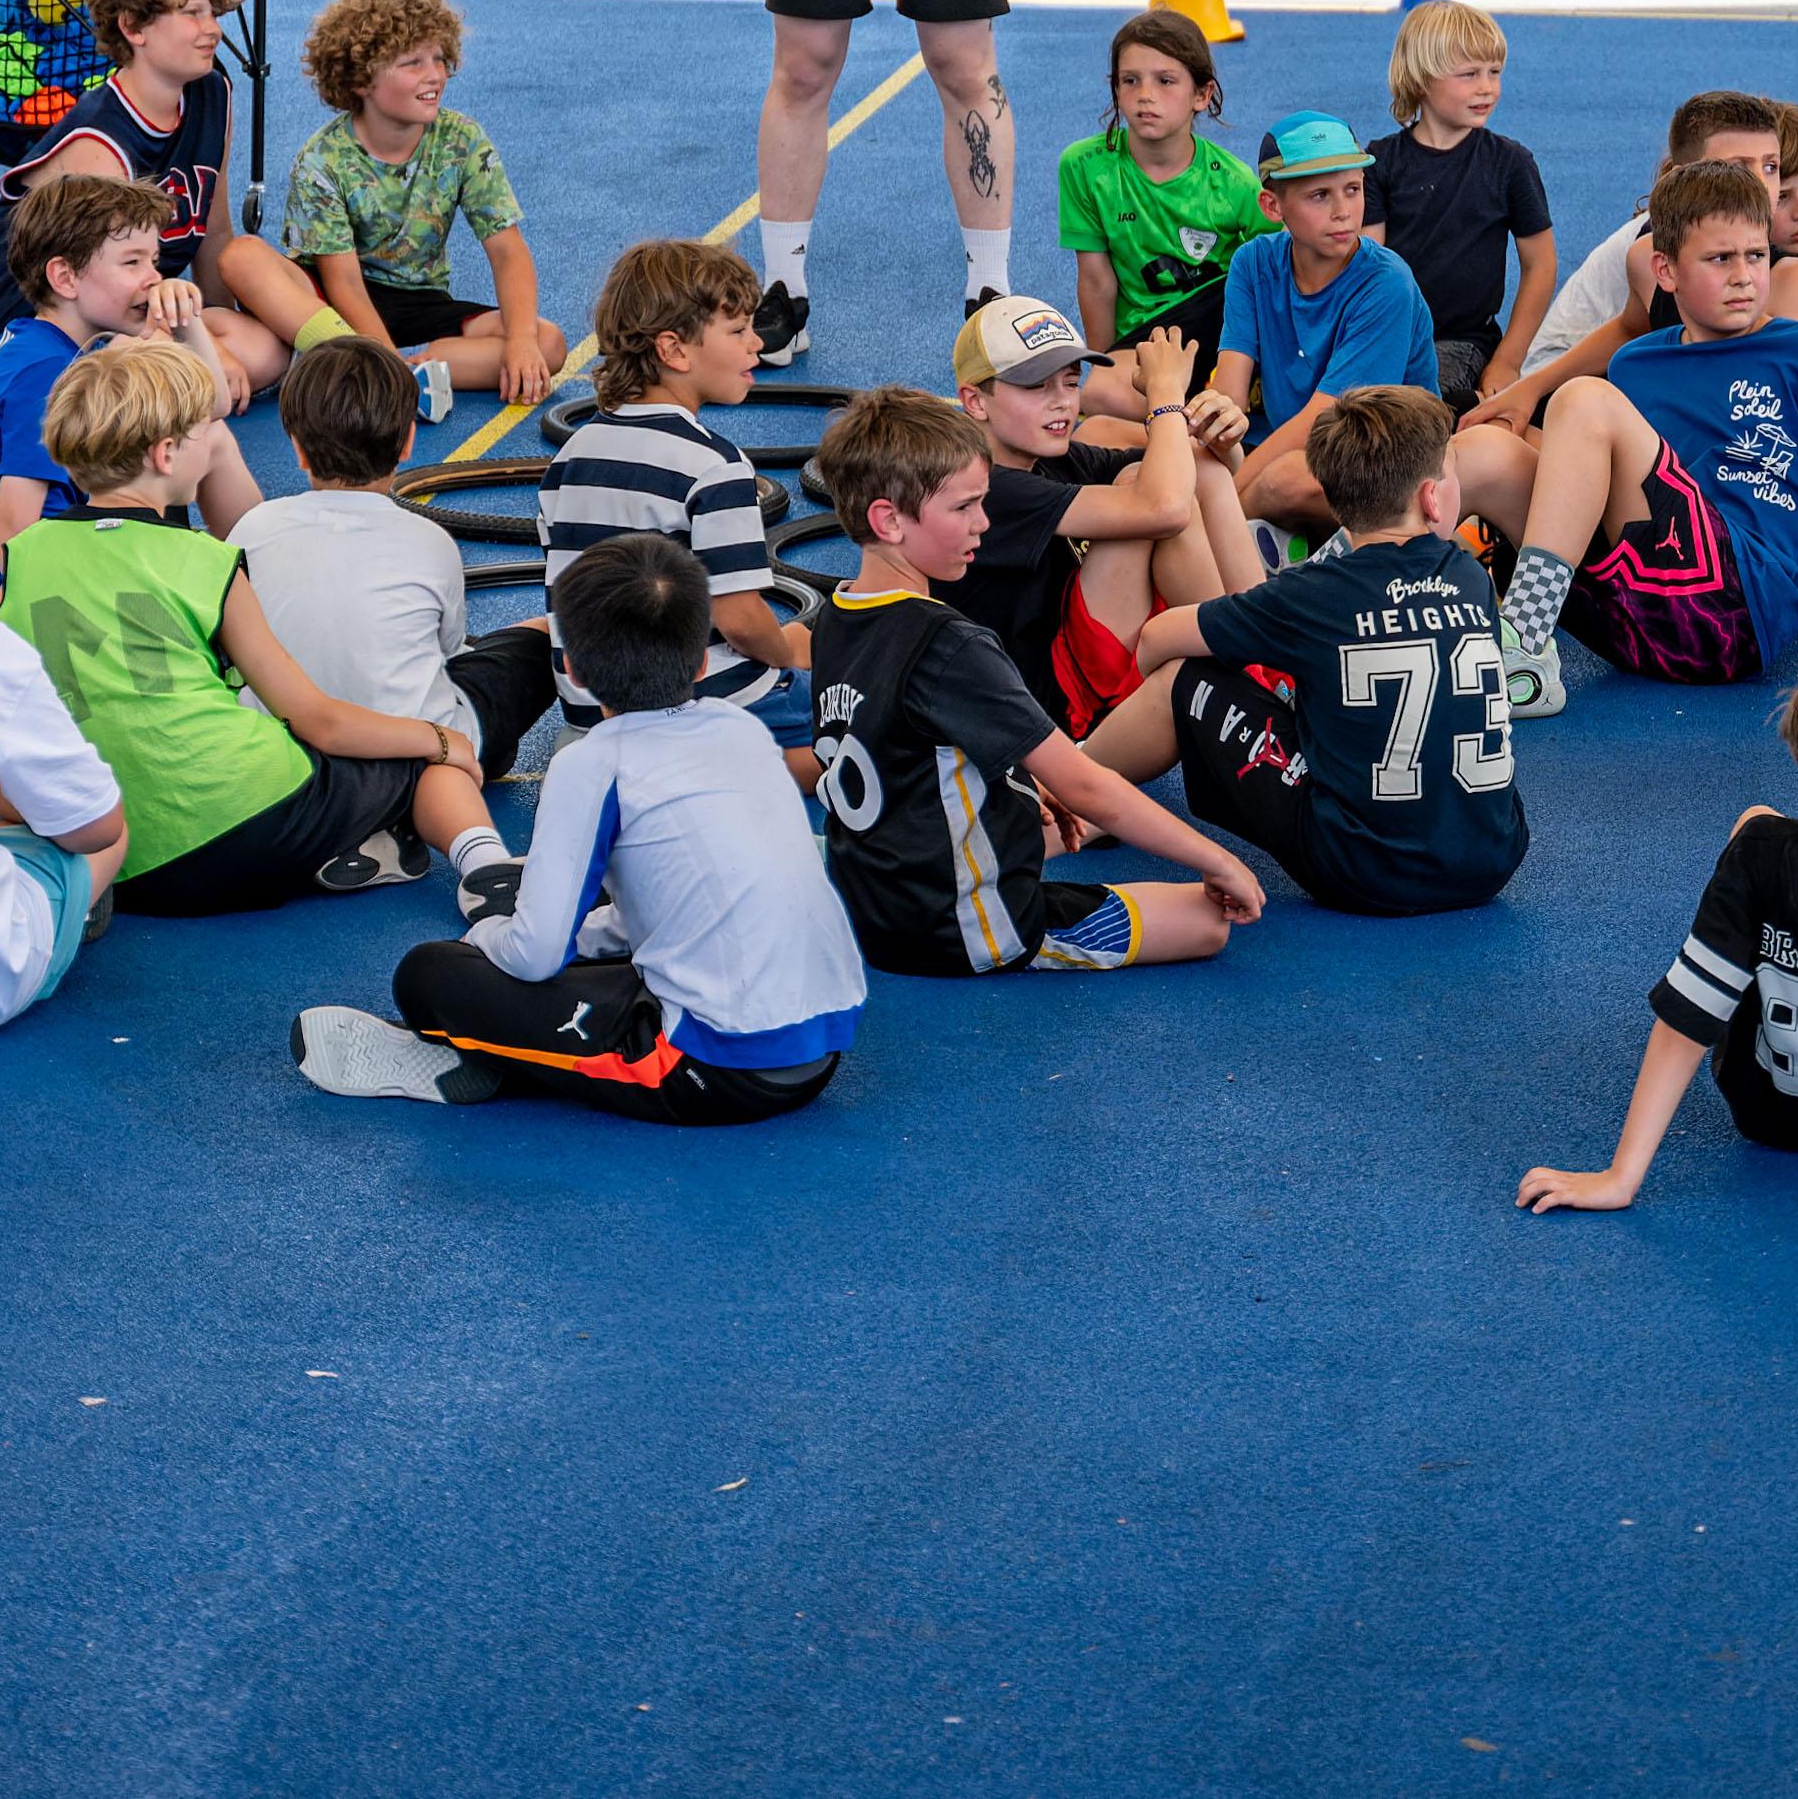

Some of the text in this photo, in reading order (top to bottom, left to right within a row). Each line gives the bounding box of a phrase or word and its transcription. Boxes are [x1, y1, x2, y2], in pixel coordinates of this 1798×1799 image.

[1728, 379, 1776, 403] Plein
[1730, 399, 1783, 421] soleil
[1716, 465, 1773, 485] Sunset
[1753, 483, 1797, 512] vibes
[1355, 604, 1492, 637] HEIGHTS
[1337, 633, 1515, 801] 73
